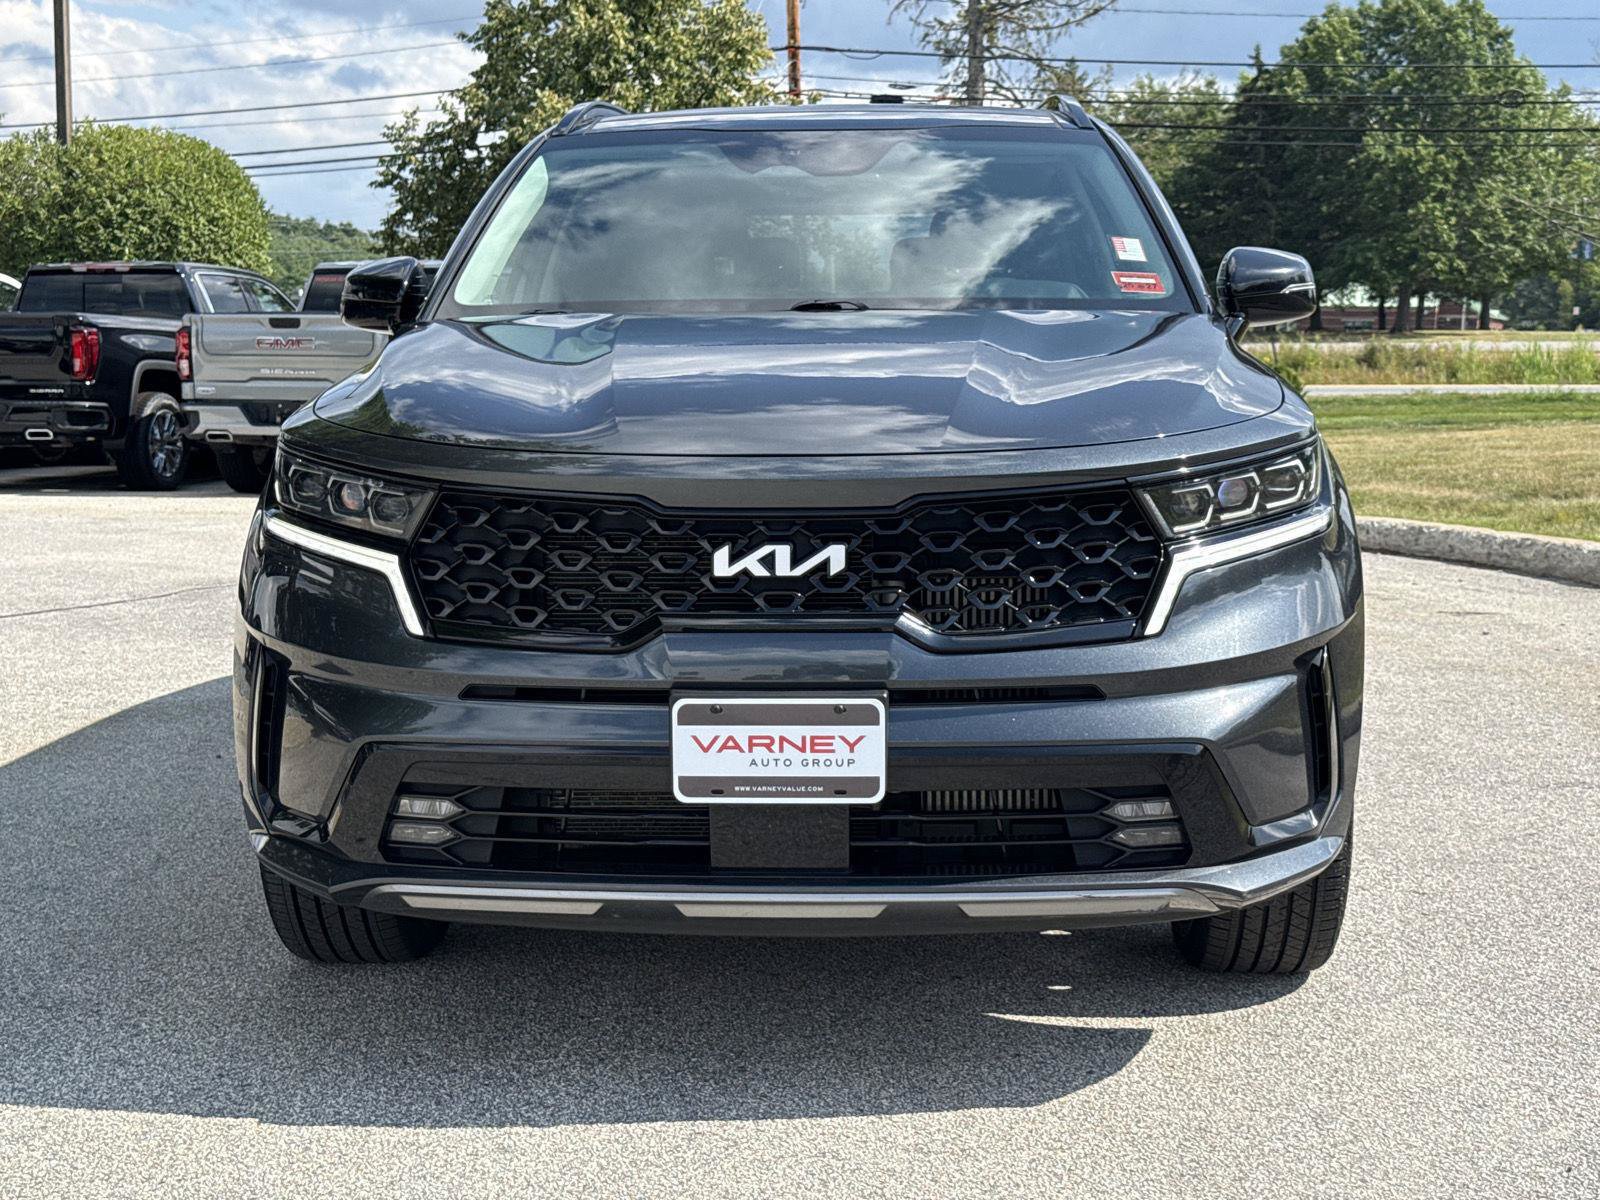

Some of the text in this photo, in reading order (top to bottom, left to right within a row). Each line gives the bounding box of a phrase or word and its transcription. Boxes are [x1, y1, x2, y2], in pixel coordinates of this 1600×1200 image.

[256, 336, 316, 350] GMC
[713, 544, 846, 577] KIA
[691, 735, 867, 753] VARNEY
[749, 758, 856, 767] AUTO GROUP
